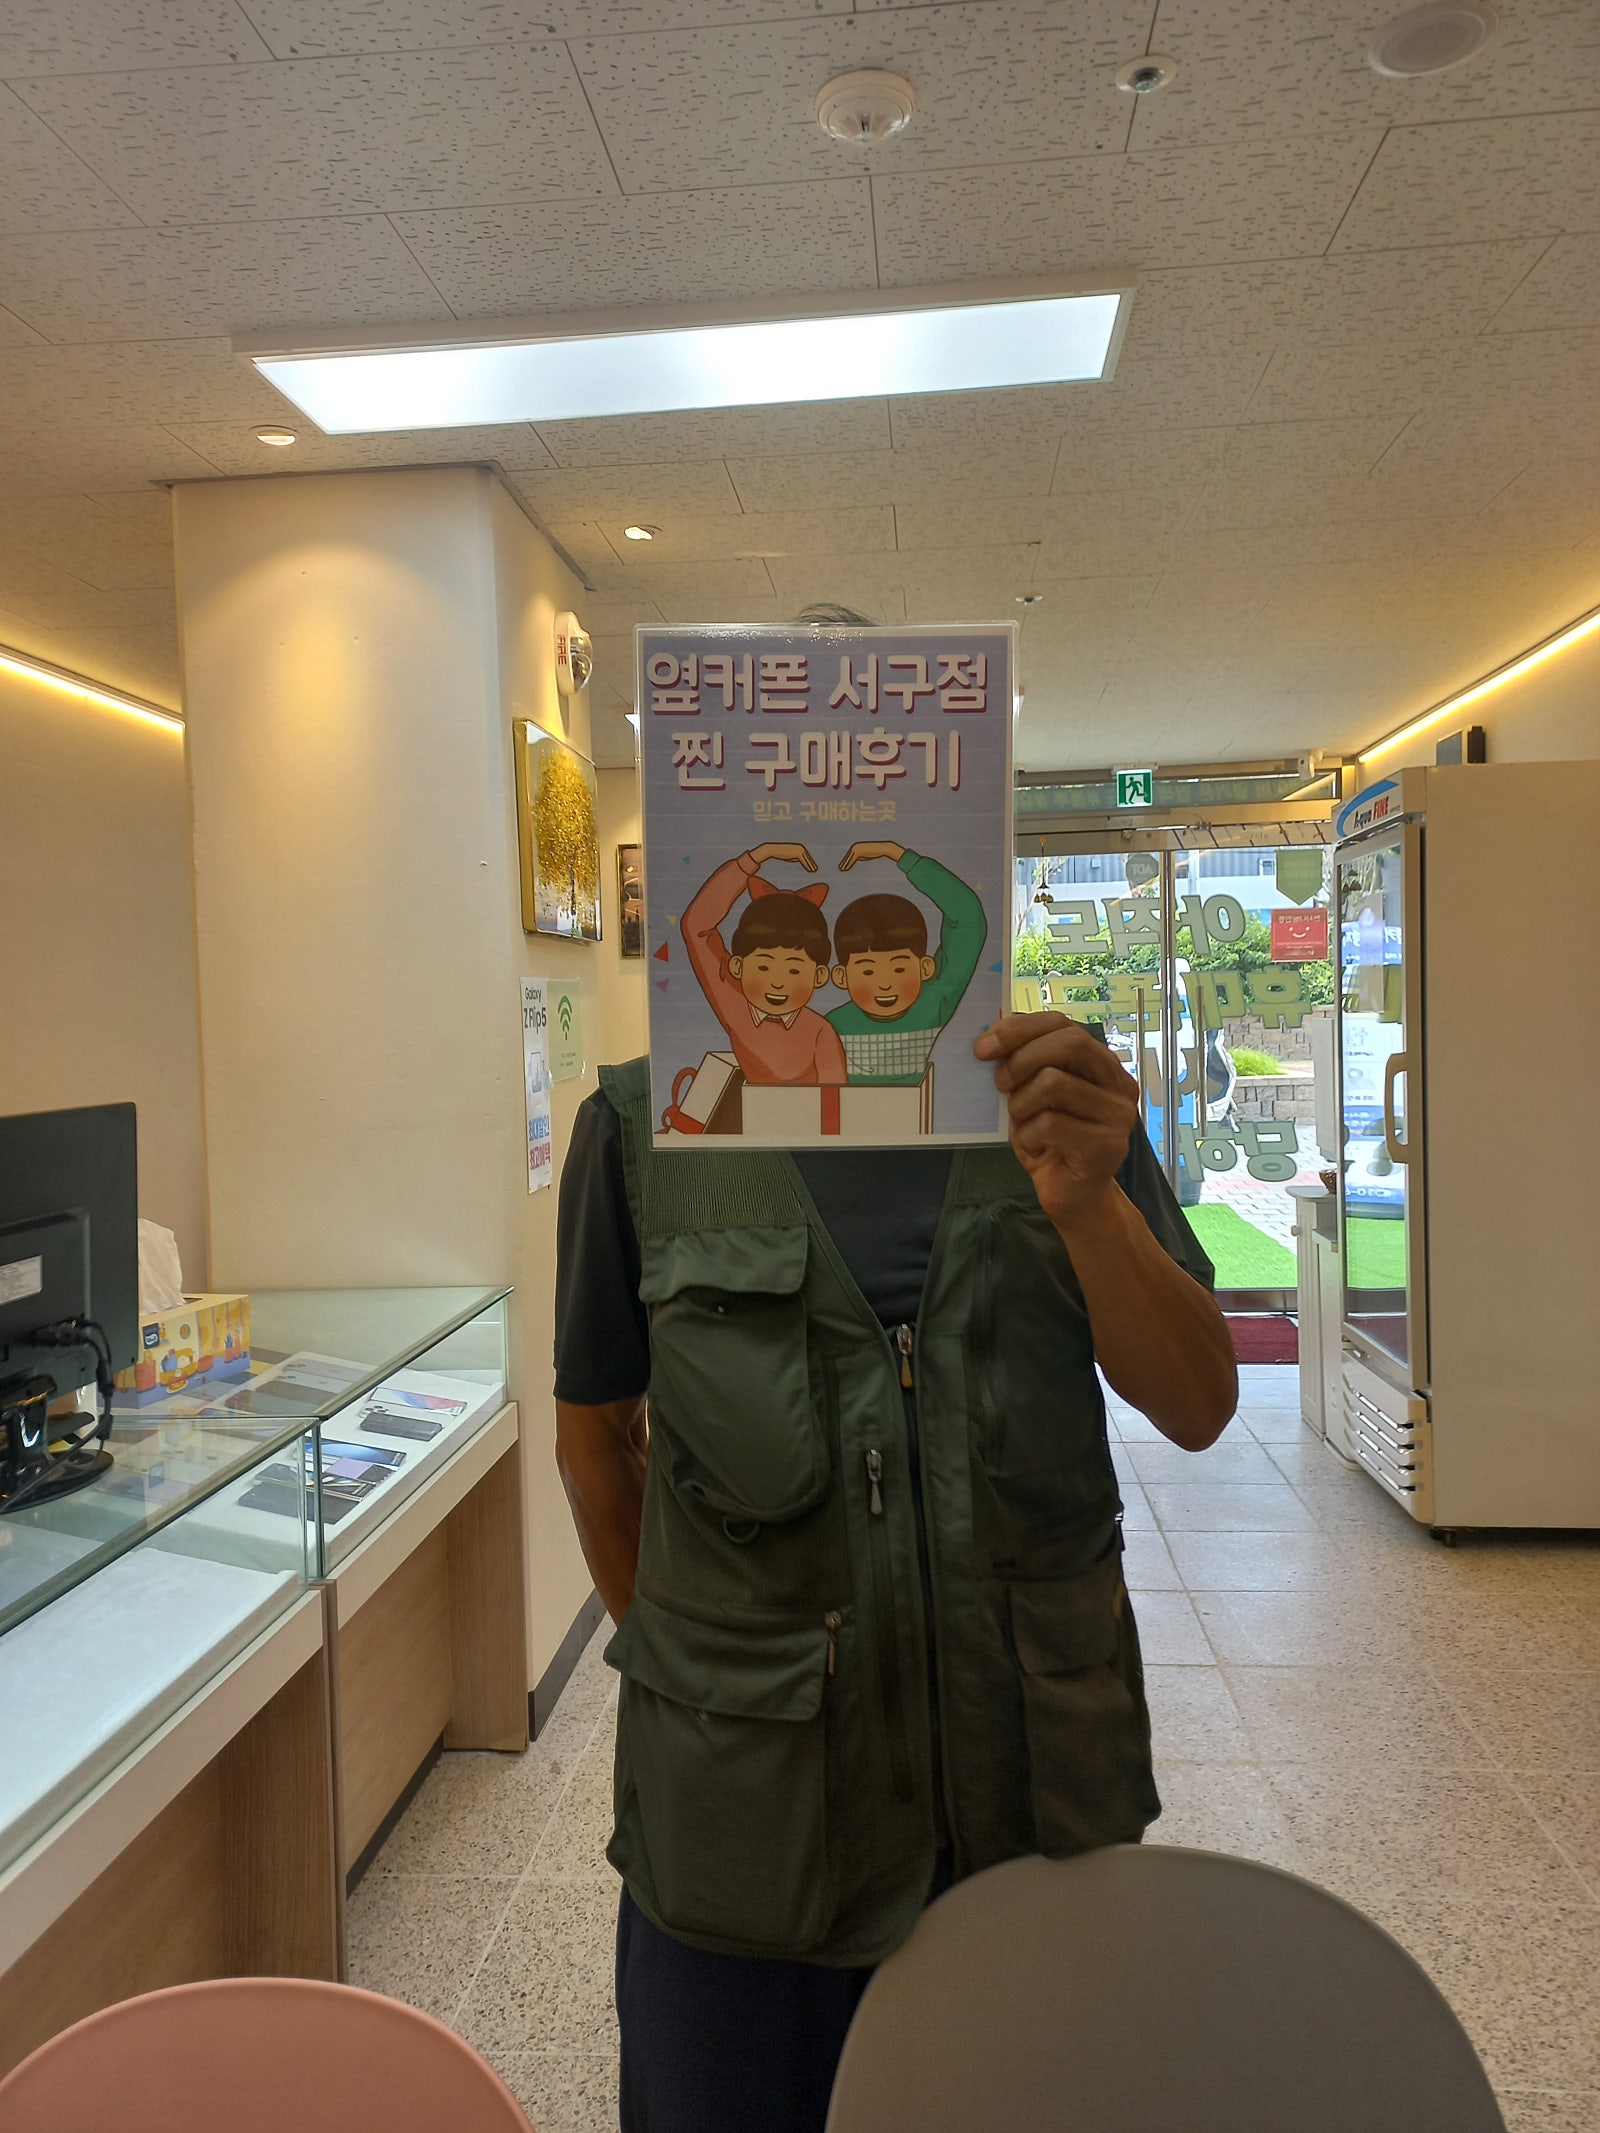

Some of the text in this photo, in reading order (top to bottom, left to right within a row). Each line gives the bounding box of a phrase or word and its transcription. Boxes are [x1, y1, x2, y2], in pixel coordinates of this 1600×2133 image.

[646, 652, 989, 716] 옆커폰 서구점
[671, 727, 961, 792] 찐 구매후기
[753, 800, 896, 823] 믿고 구매하는곳
[1373, 796, 1389, 820] FINE
[525, 986, 543, 1005] Galaxy
